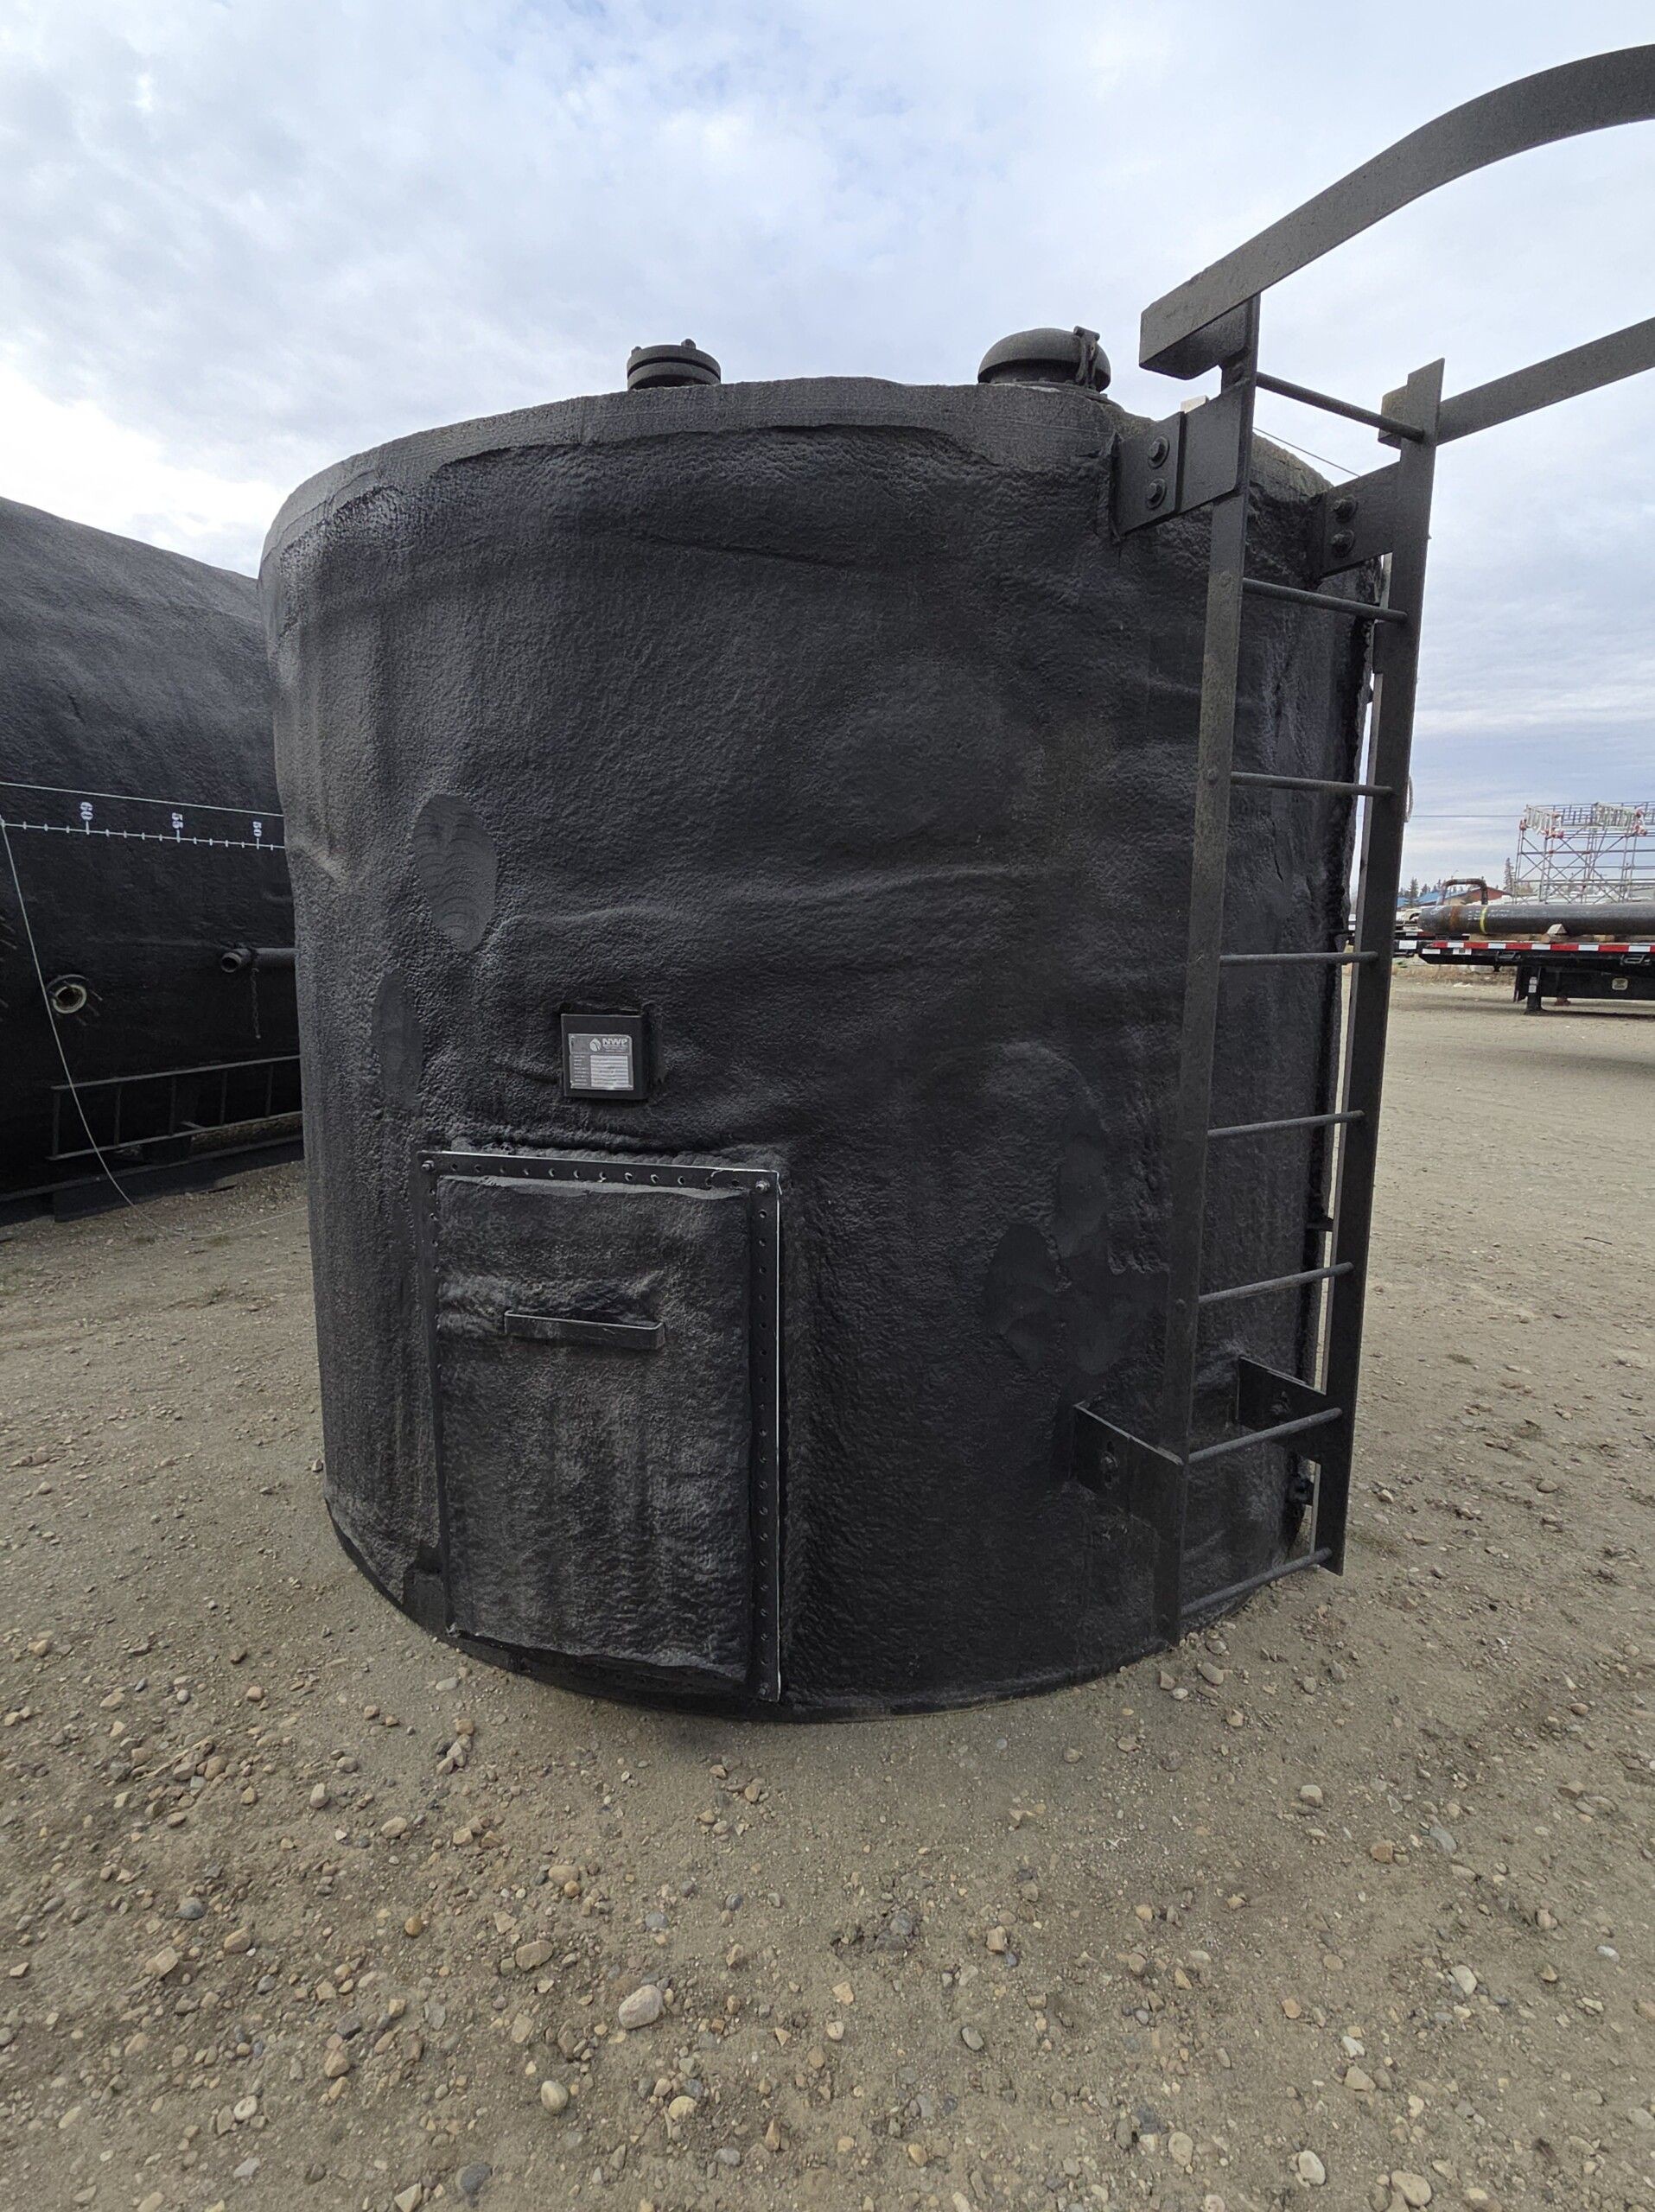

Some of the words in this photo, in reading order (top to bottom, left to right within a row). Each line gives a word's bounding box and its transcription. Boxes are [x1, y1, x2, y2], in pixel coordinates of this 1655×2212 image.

[80, 801, 93, 821] 60
[171, 812, 184, 829] 55
[252, 821, 263, 837] 50
